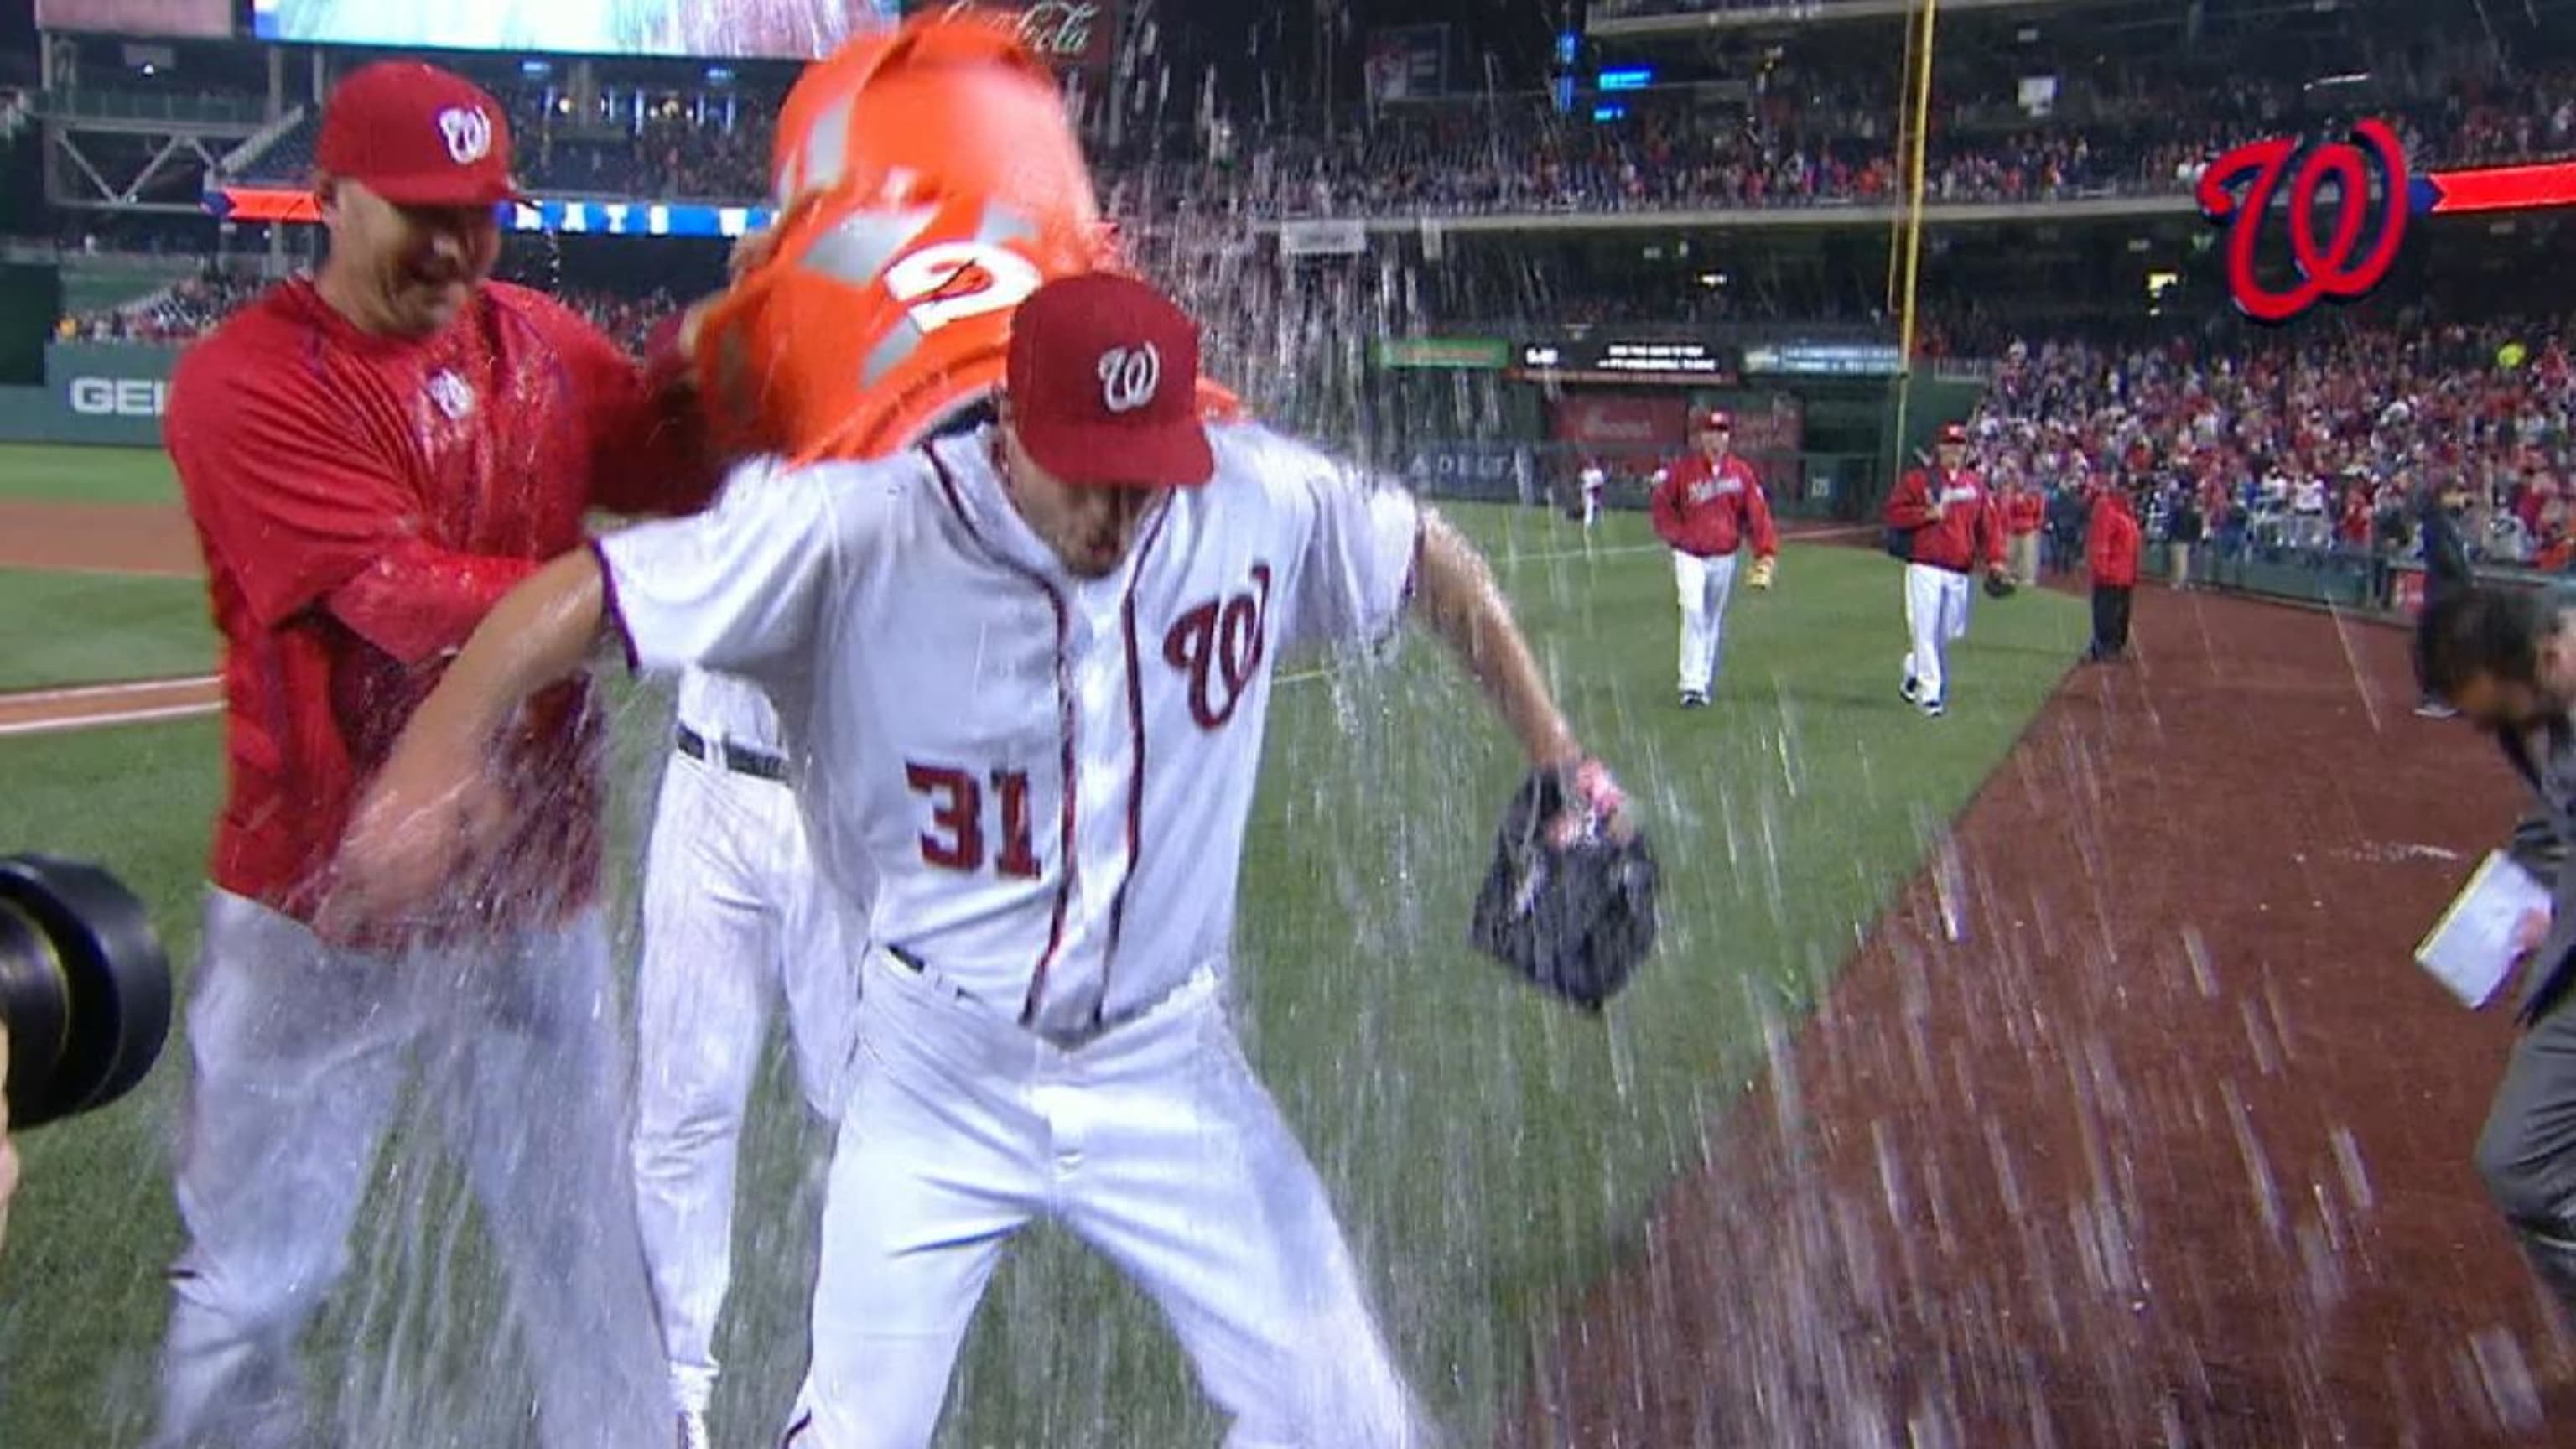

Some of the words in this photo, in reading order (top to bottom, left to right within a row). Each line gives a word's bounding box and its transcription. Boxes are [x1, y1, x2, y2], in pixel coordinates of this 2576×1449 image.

[439, 106, 492, 164] W
[70, 377, 170, 416] GEI
[1097, 339, 1161, 412] W
[1162, 561, 1271, 732] W
[905, 758, 1043, 882] 31
